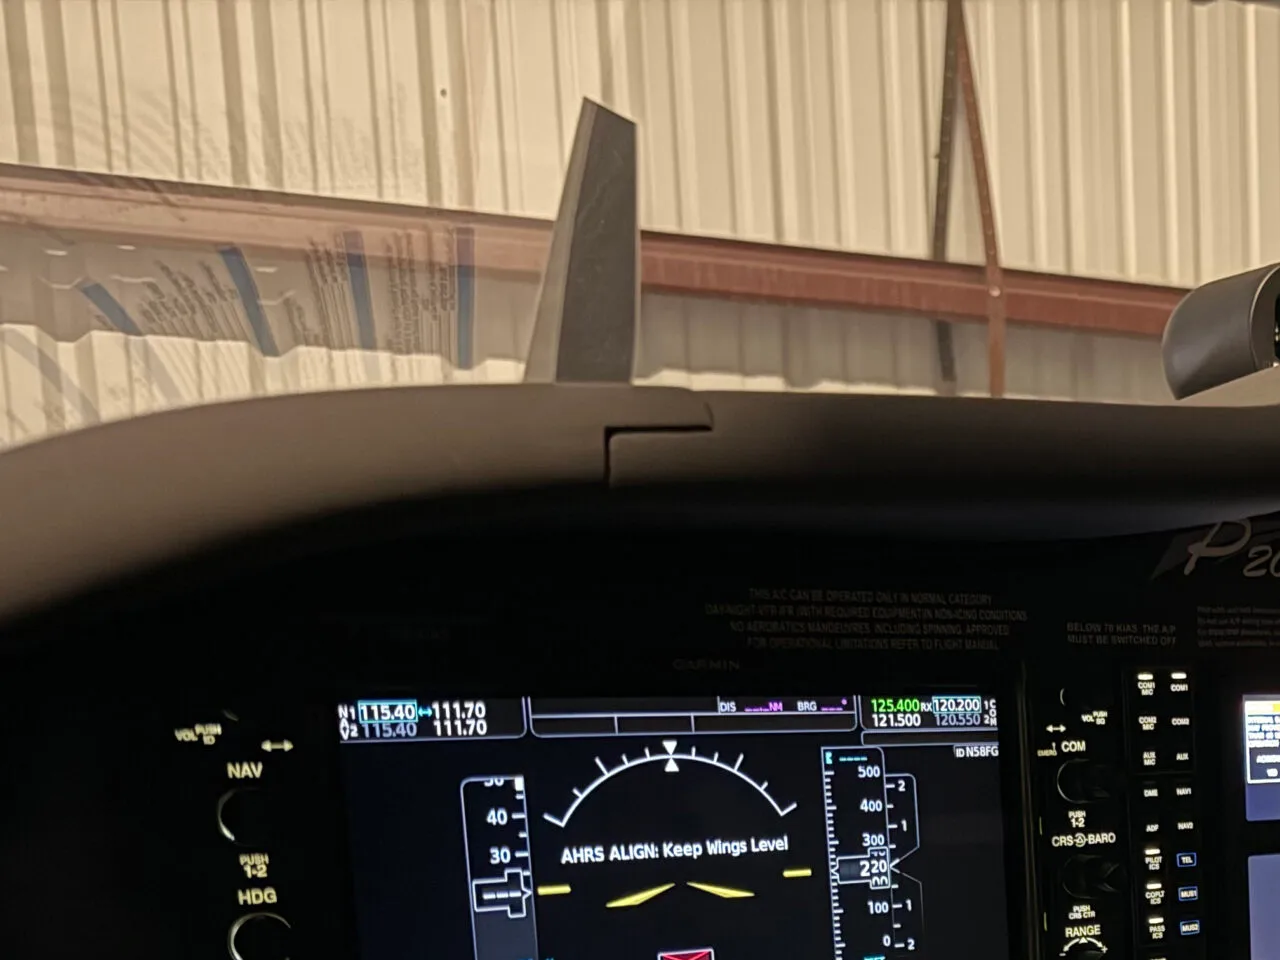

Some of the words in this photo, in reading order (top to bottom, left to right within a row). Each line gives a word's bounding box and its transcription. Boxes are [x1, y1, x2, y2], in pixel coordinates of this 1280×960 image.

[672, 657, 740, 672] GARMIN
[360, 704, 416, 720] 115.40
[432, 701, 486, 719] 111.70
[719, 702, 736, 712] DIS
[797, 701, 817, 711] BRG
[871, 699, 920, 712] 125.400
[934, 698, 980, 711] 120.200
[872, 713, 921, 727] 121.500
[935, 713, 981, 726] 120.550
[175, 727, 197, 742] VOL
[195, 723, 222, 736] PUSH
[361, 722, 418, 738] 115.40
[433, 719, 488, 736] 111.70
[966, 746, 999, 757] N58FG
[1061, 741, 1086, 752] COM
[227, 761, 263, 778] NAV
[858, 765, 880, 778] 500
[898, 780, 905, 791] 2
[860, 799, 882, 812] 400
[486, 808, 508, 825] 40
[1068, 811, 1086, 819] PUSH
[901, 819, 907, 831] 1
[862, 832, 885, 846] 300
[1052, 835, 1073, 847] CRS
[1088, 833, 1116, 845] BARO
[490, 846, 511, 864] 30
[561, 846, 604, 864] AHRS
[609, 842, 659, 861] ALIGN:
[663, 840, 702, 859] Keep
[706, 837, 747, 856] Wings
[751, 833, 788, 852] Level
[239, 853, 269, 866] PUSH
[243, 864, 268, 878] 1-2
[237, 886, 277, 905] HDG
[867, 900, 889, 914] 100
[906, 898, 912, 911] 1
[1073, 905, 1091, 913] PUSH
[1065, 924, 1101, 938] RANGE
[882, 935, 891, 947] 0
[908, 937, 915, 949] 2
